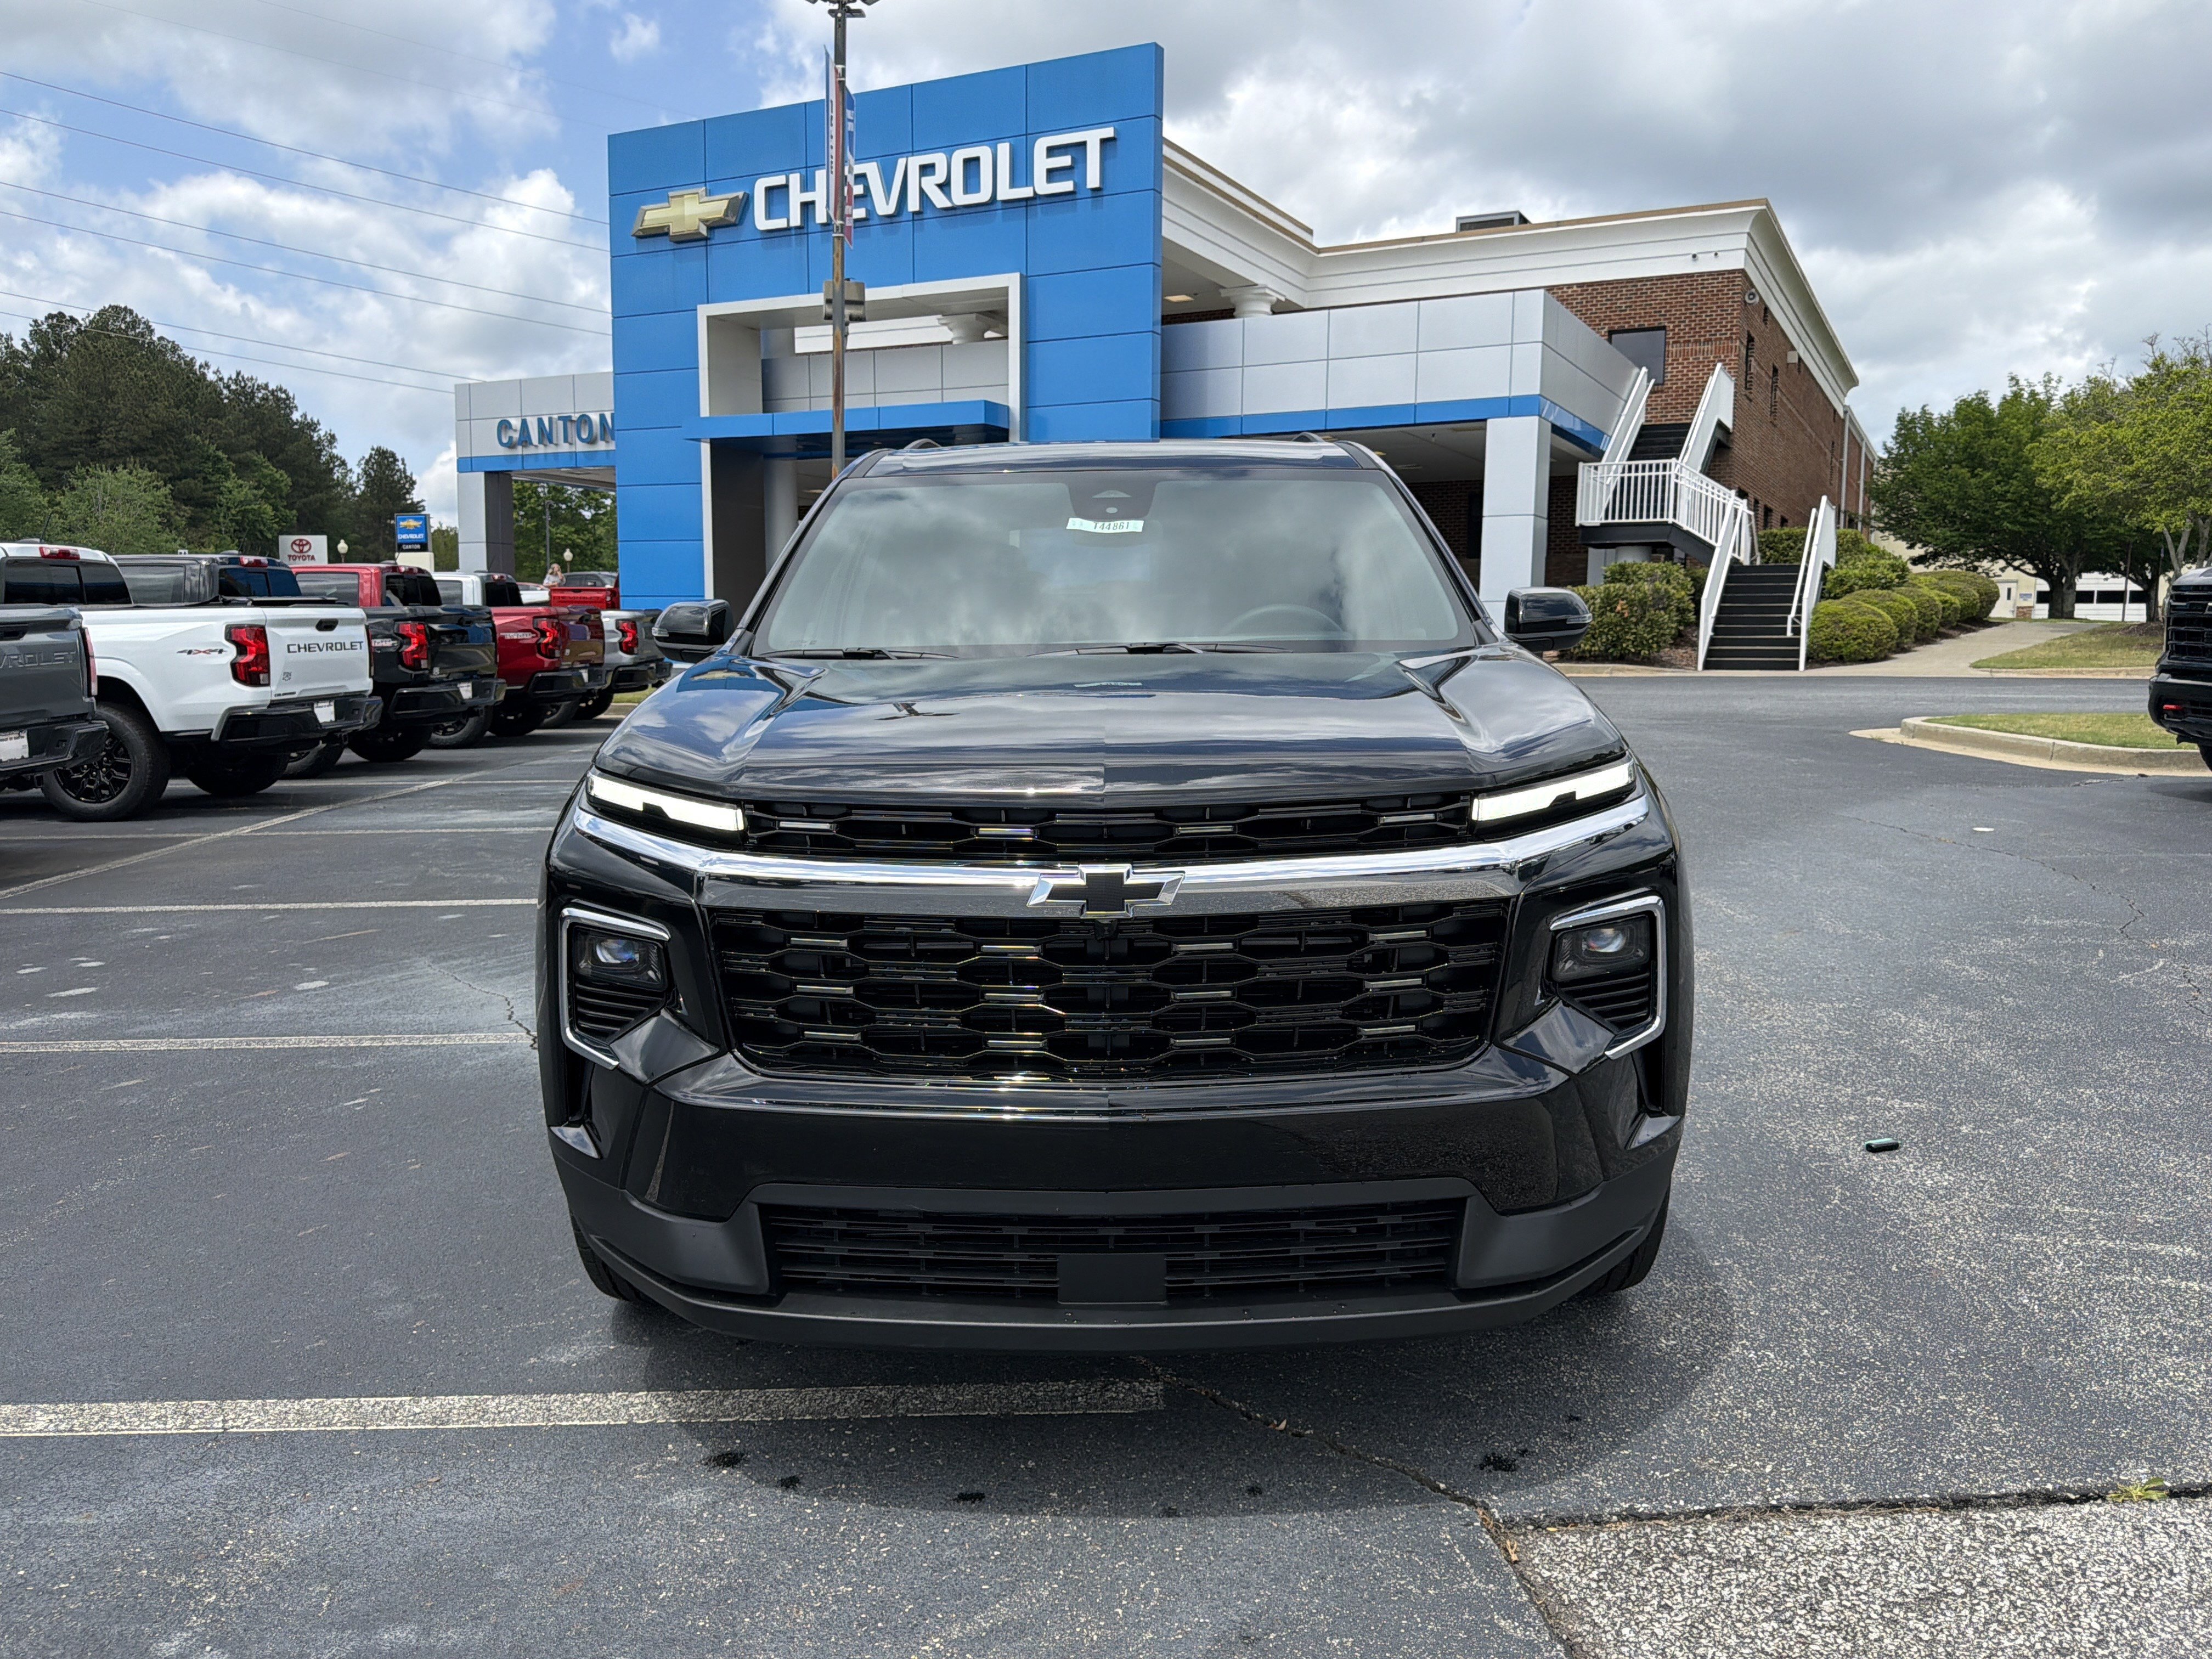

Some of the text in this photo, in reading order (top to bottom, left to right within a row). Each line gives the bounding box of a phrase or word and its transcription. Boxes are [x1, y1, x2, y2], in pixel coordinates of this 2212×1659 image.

[754, 126, 1116, 231] CHEVROLET
[496, 413, 615, 448] CANTON
[1093, 522, 1129, 531] T44861
[287, 641, 364, 653] CHEVROLET
